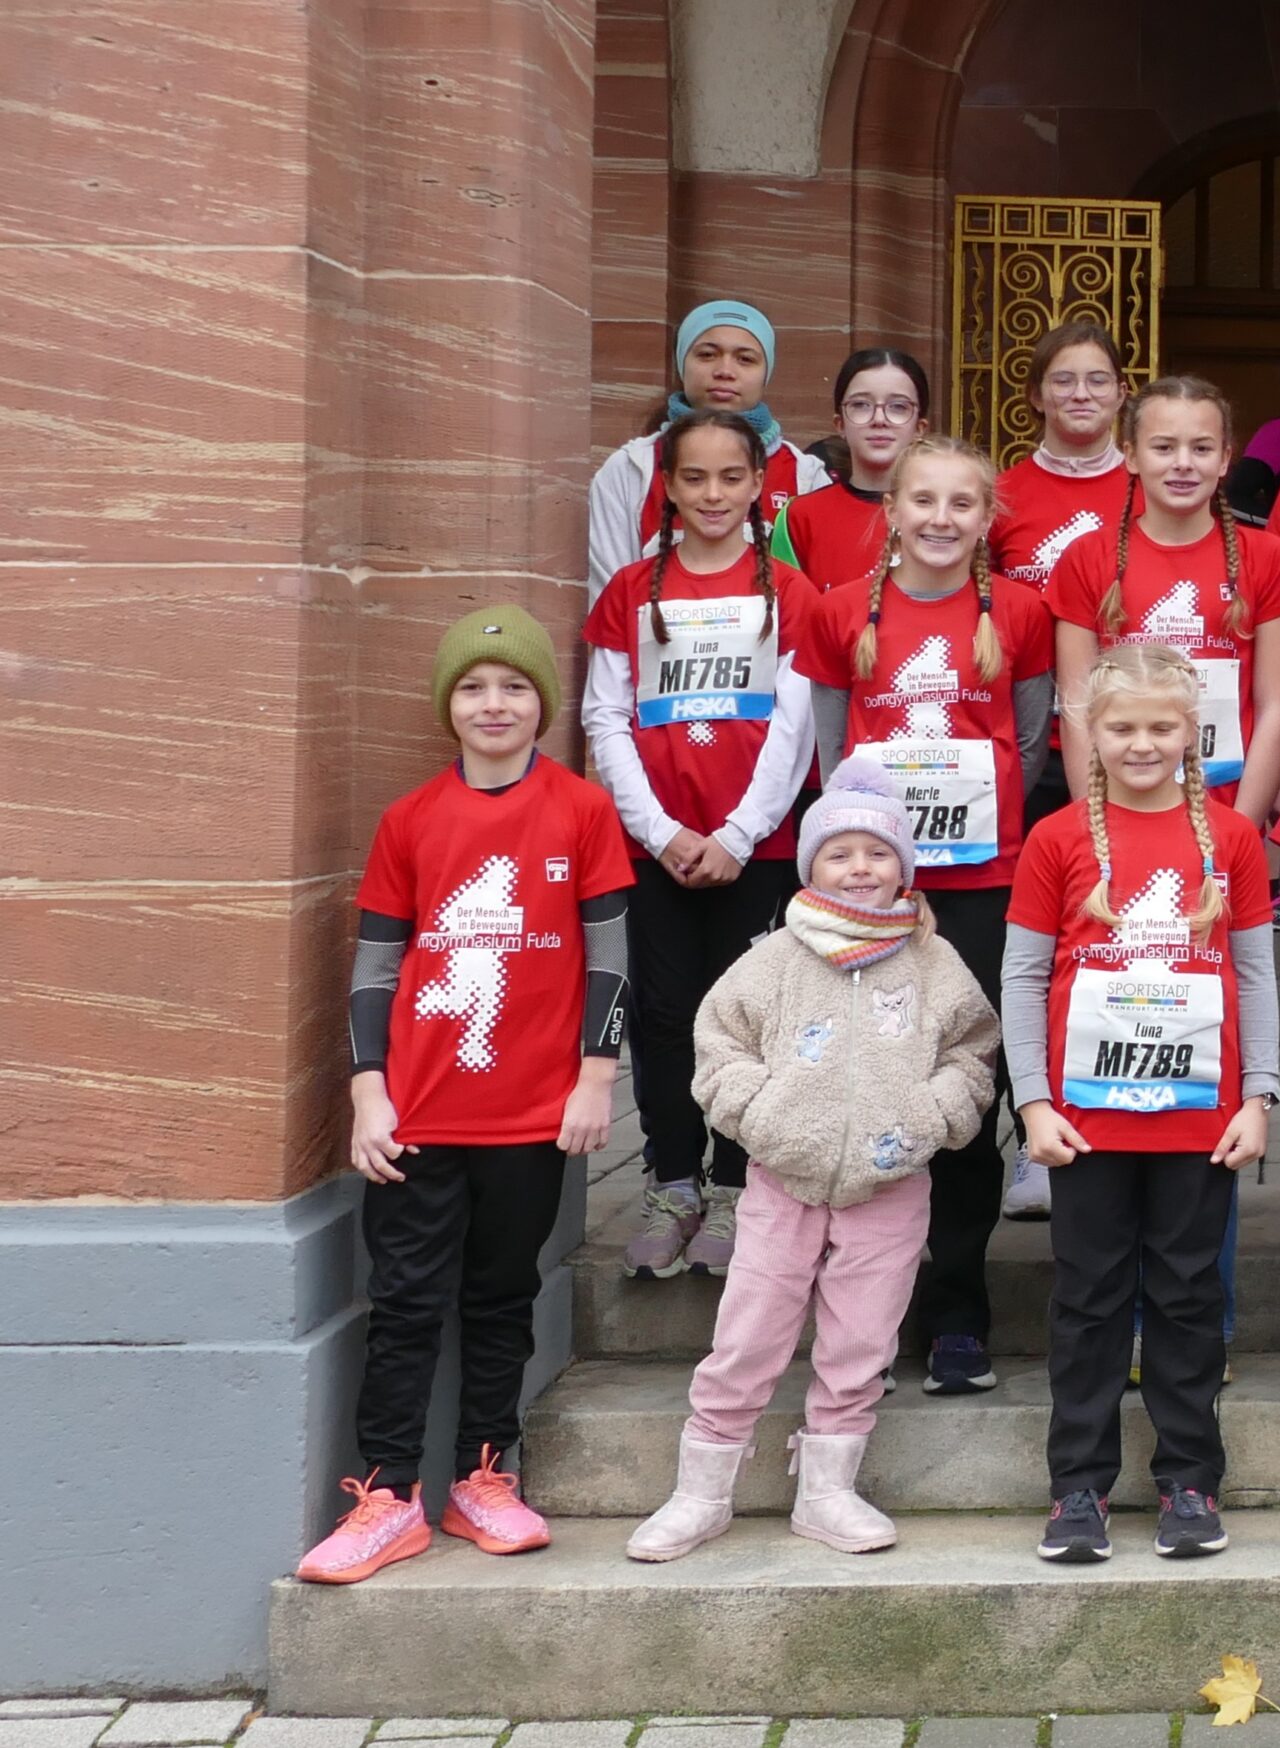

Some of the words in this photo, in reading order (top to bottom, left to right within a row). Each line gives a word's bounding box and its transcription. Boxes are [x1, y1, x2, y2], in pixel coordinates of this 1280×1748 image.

[664, 605, 742, 620] SPORTSTADT
[1156, 615, 1167, 623] Der
[1169, 615, 1195, 624] Mensch
[1158, 624, 1165, 632] in
[1166, 624, 1201, 634] Bewegung
[693, 641, 719, 654] Luna
[1113, 634, 1204, 647] Domgymnasium
[1207, 635, 1235, 650] Fulda
[658, 656, 752, 694] MF785
[907, 673, 919, 681] Der
[920, 672, 948, 680] Mensch
[909, 682, 917, 690] in
[918, 681, 956, 691] Bewegung
[864, 691, 959, 708] Domgymnasium
[962, 689, 992, 703] Fulda
[671, 696, 738, 719] HOKA
[881, 749, 961, 763] SPORTSTADT
[905, 786, 940, 801] Merle
[457, 907, 473, 918] Der
[475, 907, 510, 918] Mensch
[458, 920, 468, 930] in
[470, 919, 519, 935] Bewegung
[1128, 919, 1144, 930] Der
[1145, 918, 1178, 929] Mensch
[417, 934, 522, 952] mgymnasium
[526, 932, 561, 949] Fulda
[1130, 931, 1139, 941] in
[1141, 931, 1187, 944] Bewegung
[1072, 944, 1190, 963] Domgymnasium
[1106, 981, 1191, 998] SPORTSTADT
[610, 1007, 624, 1045] CMP
[1134, 1022, 1163, 1039] Luna
[1093, 1040, 1194, 1080] MF789
[1105, 1085, 1177, 1107] HOKA
